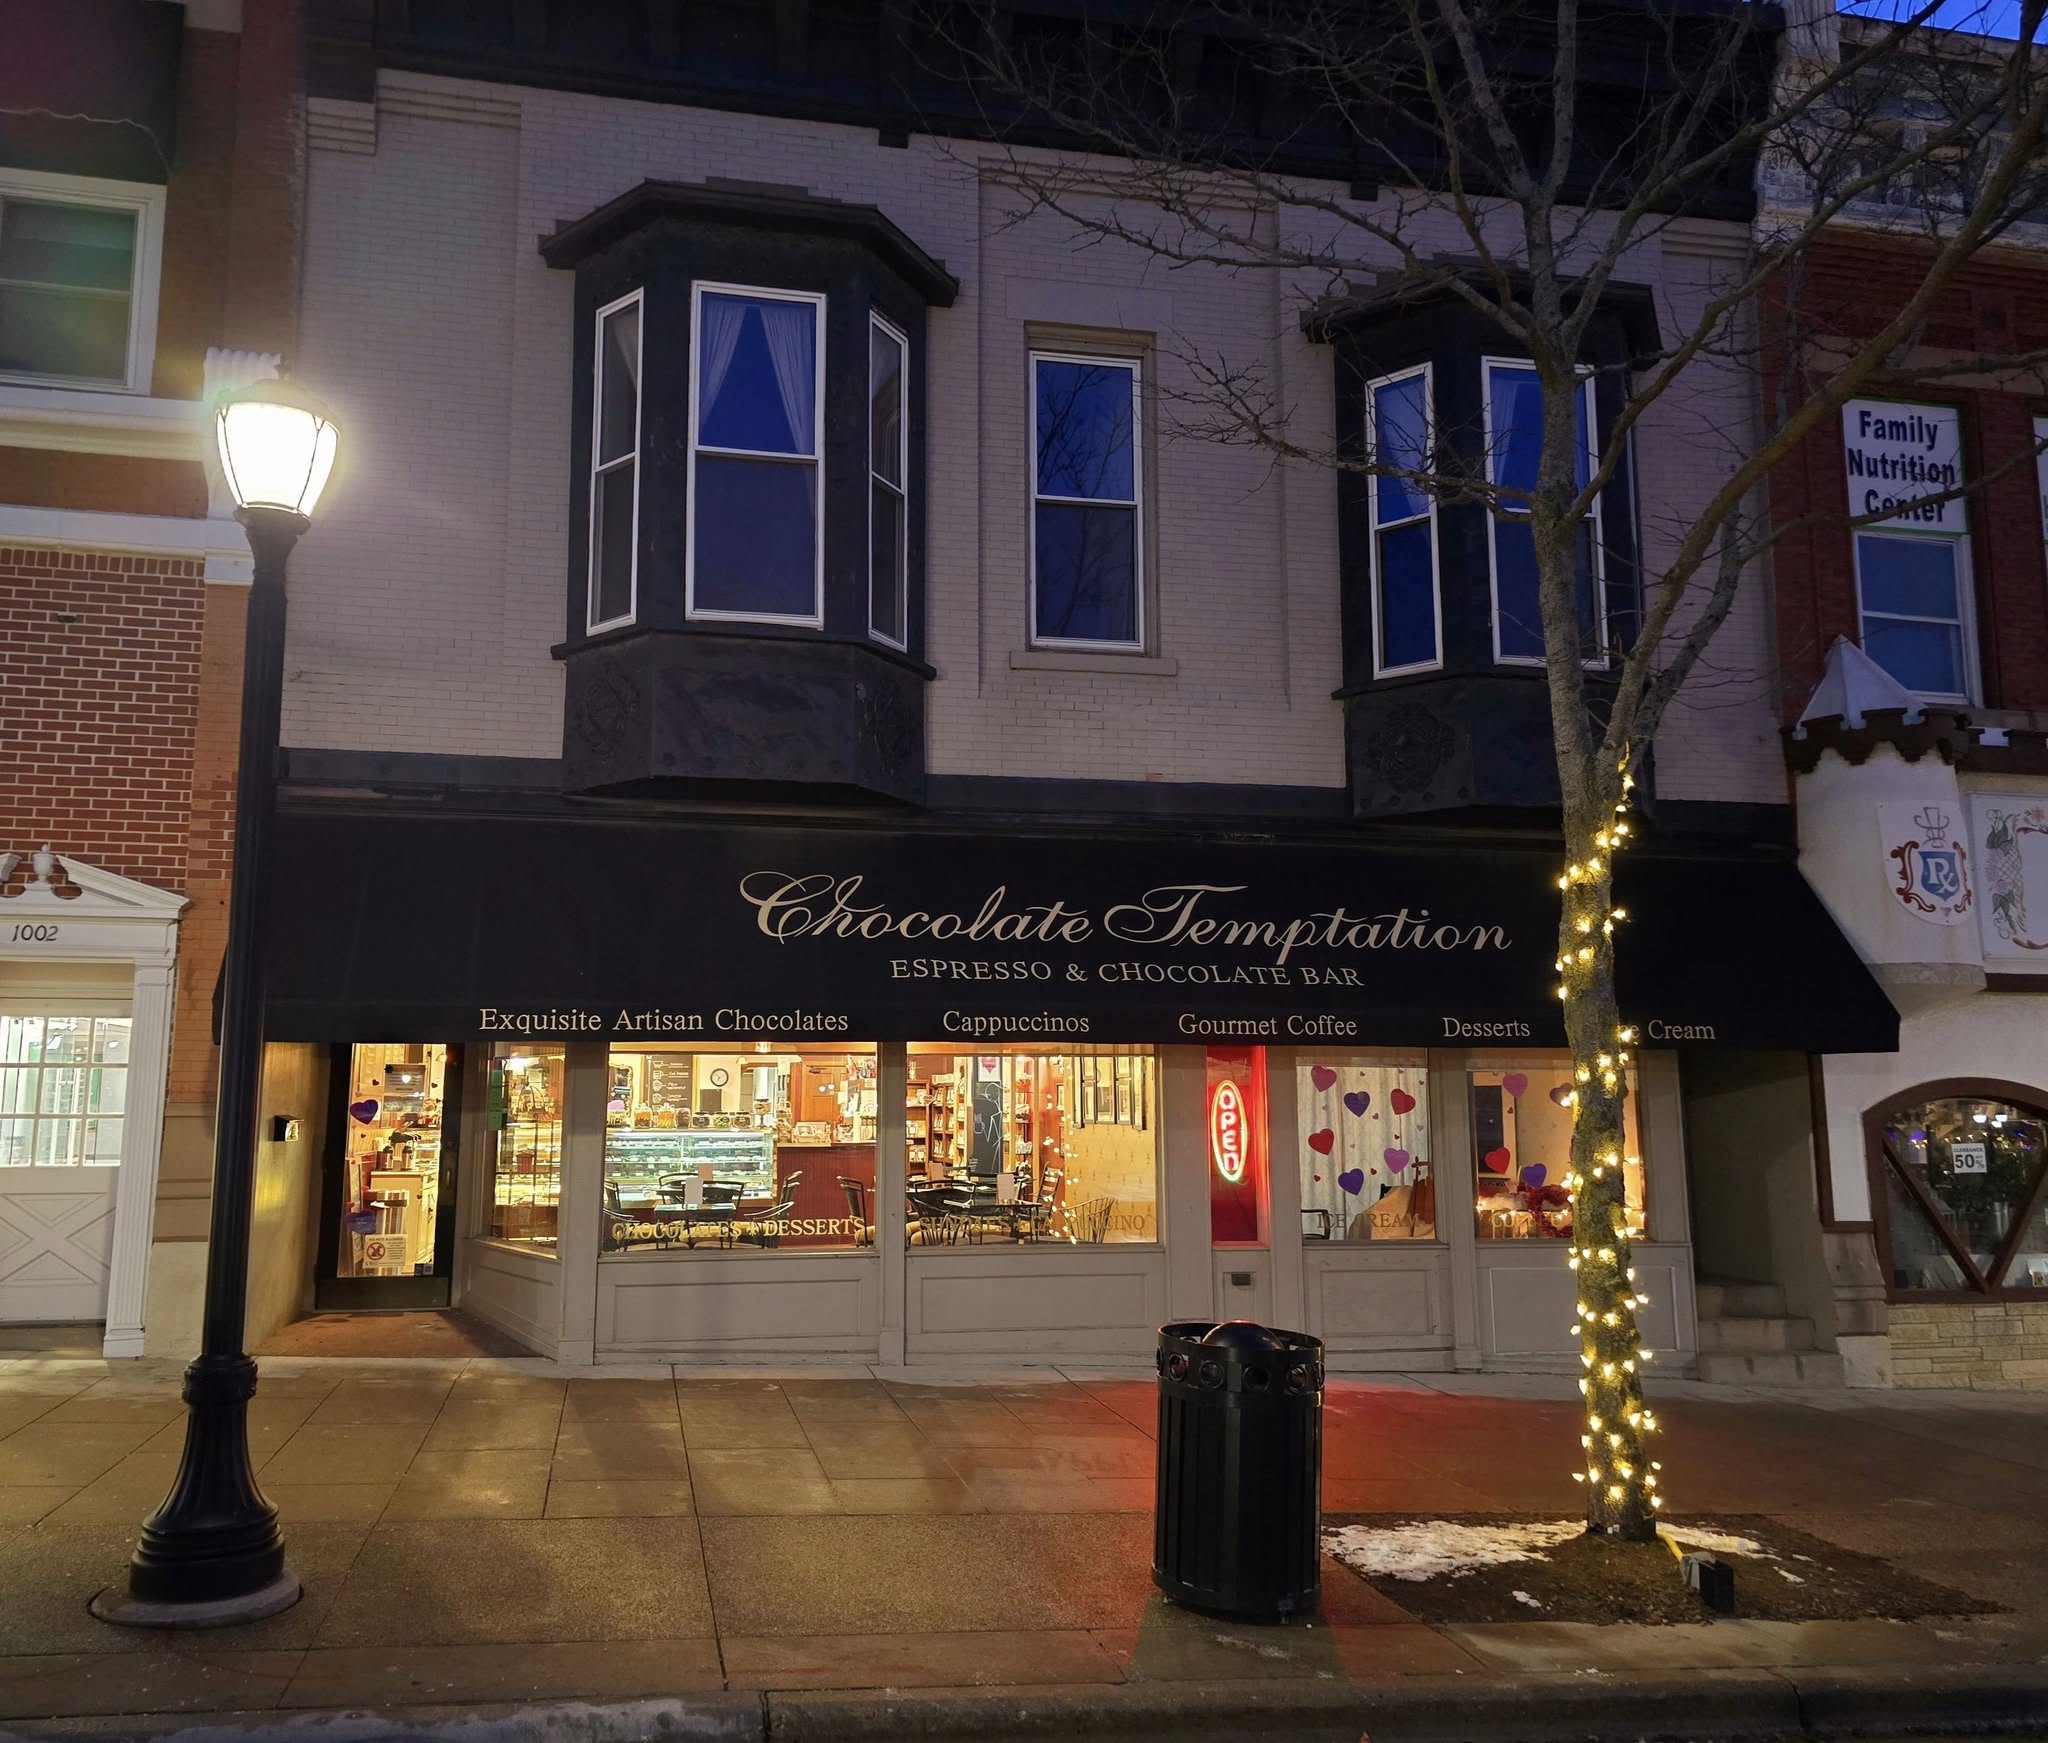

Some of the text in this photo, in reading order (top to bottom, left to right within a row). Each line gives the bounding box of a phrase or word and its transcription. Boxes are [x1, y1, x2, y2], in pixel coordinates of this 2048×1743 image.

[1859, 410, 1938, 451] Family
[1848, 448, 1955, 485] Nutrition
[739, 870, 1513, 966] Chocolate Temptation
[12, 924, 59, 942] 1002
[890, 958, 1364, 988] ESPRESSO & CHOCOLATE BAR
[479, 1007, 849, 1034] Exquisite Artisan Chocolates
[942, 1011, 1090, 1036] Cappuccinos
[1178, 1014, 1358, 1036] Gourmet Coffee
[1442, 1016, 1531, 1038] Desserts
[1648, 1019, 1716, 1040] Cream
[612, 1217, 868, 1241] CHOCOLATES DESSERTS
